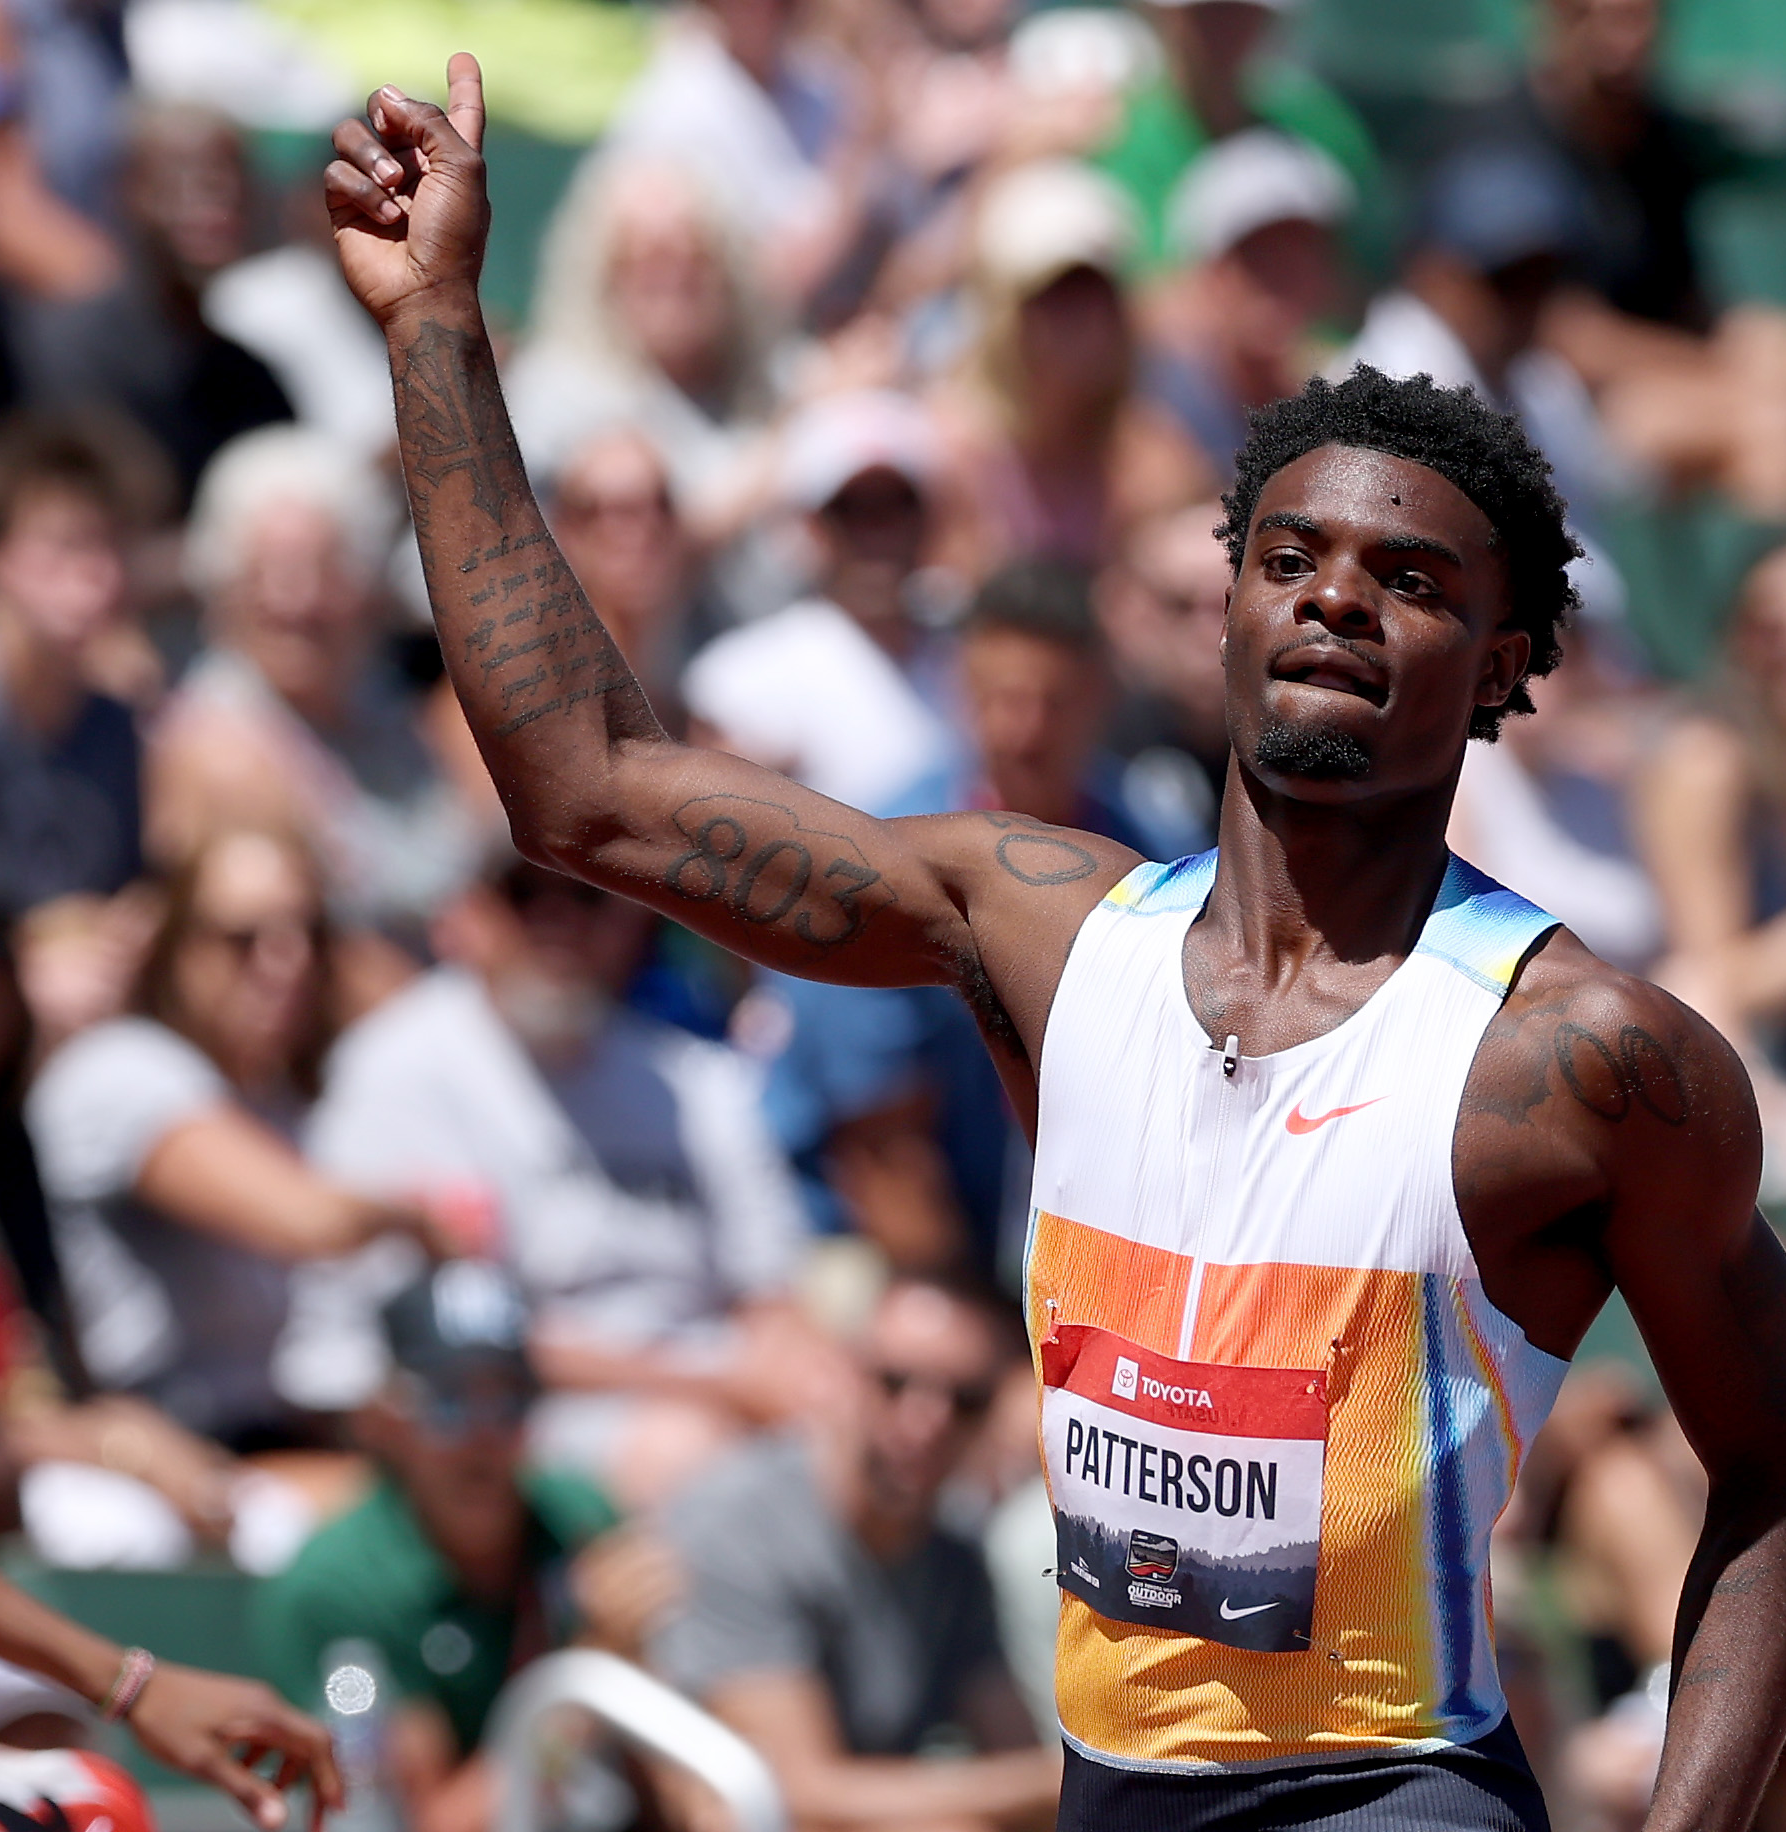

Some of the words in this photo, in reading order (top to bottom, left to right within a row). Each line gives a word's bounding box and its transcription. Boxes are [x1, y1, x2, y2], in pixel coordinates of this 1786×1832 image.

[663, 815, 881, 946] 803
[1141, 1376, 1213, 1409] TOYOTA
[1066, 1417, 1278, 1520] PATTERSON
[1127, 1584, 1182, 1605] OUTDOOR
